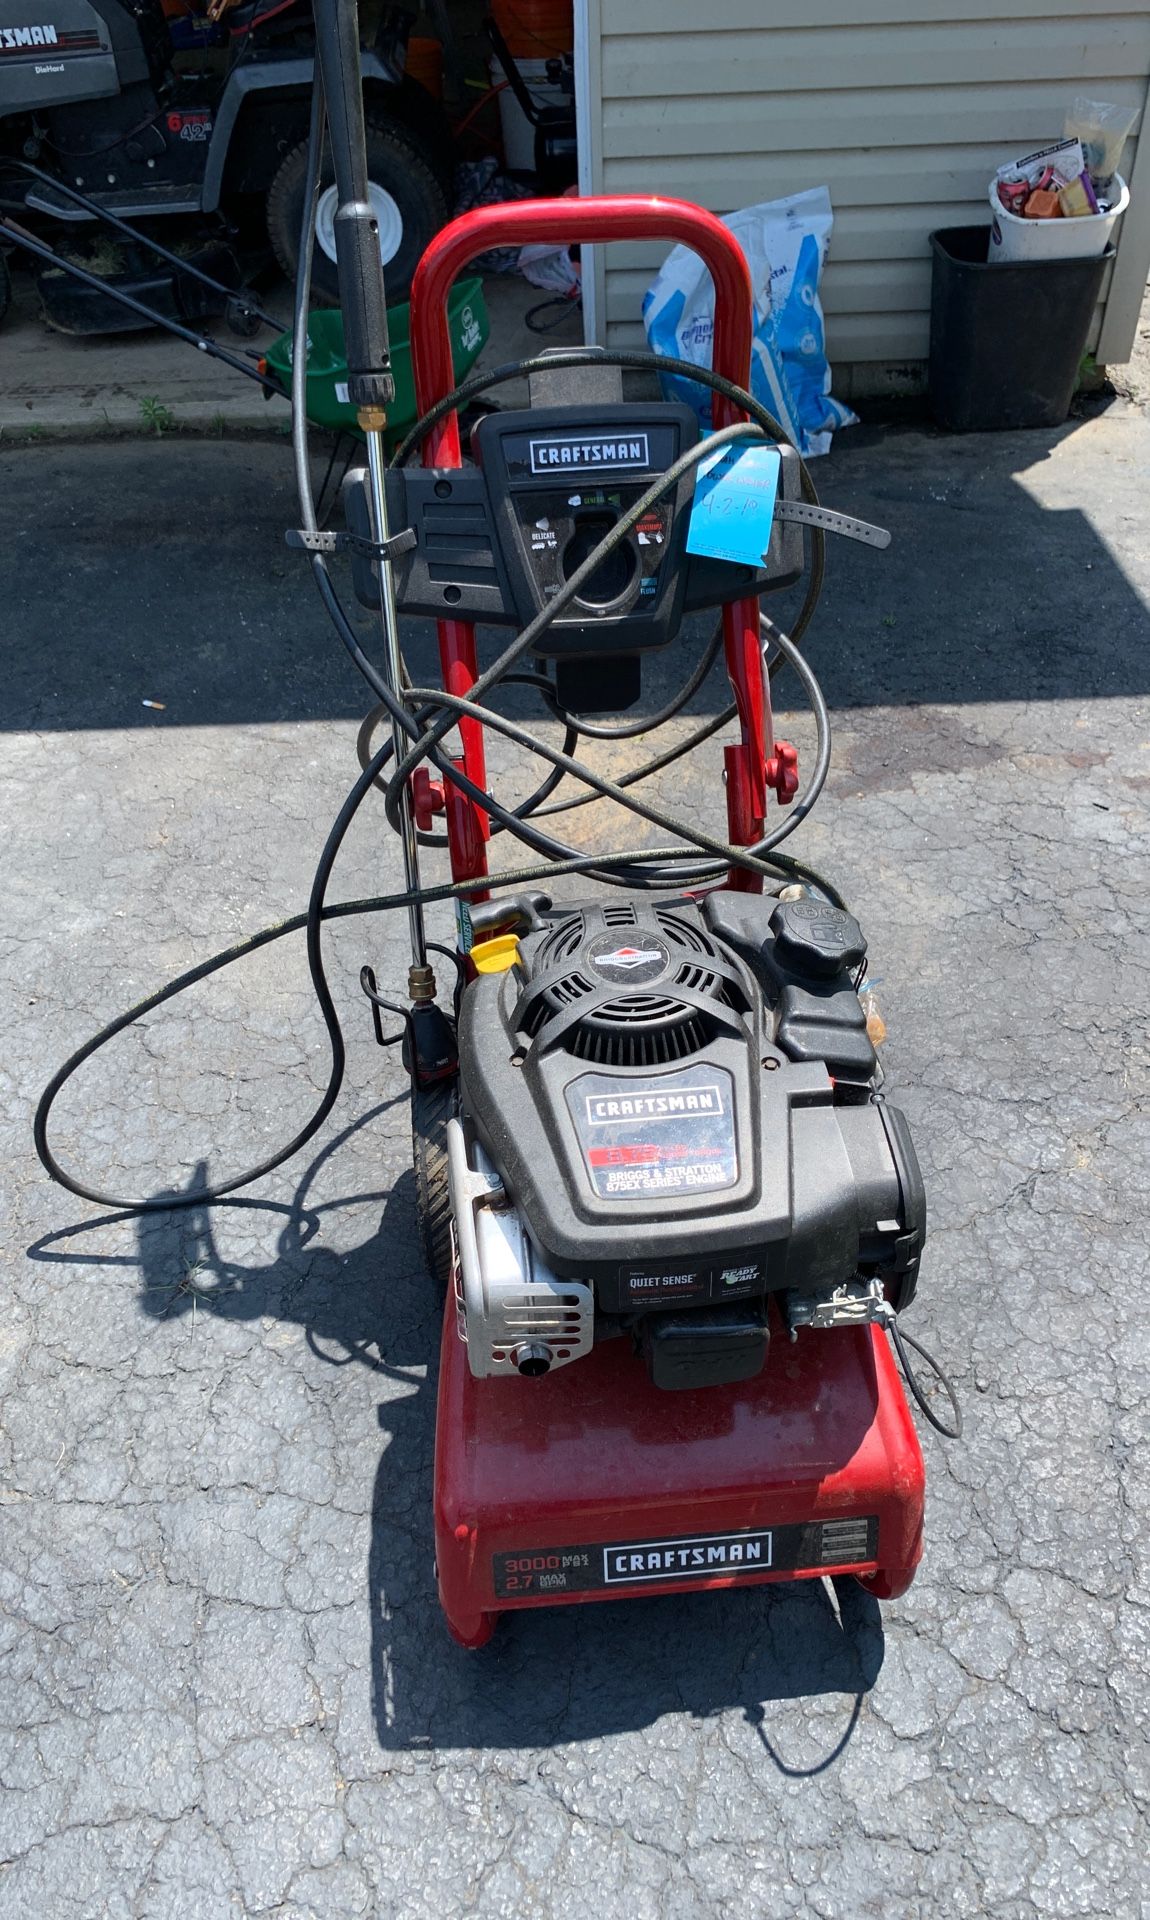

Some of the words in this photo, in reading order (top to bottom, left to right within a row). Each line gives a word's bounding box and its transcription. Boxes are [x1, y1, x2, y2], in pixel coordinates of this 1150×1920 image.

[0, 25, 58, 48] SMAN
[35, 64, 65, 74] DieHard
[167, 113, 181, 133] 6
[538, 443, 641, 464] CRAFTSMAN
[531, 532, 556, 540] DELICATE
[595, 1093, 713, 1117] CRAFTSMAN
[606, 1179, 641, 1192] 875EX
[643, 1176, 682, 1189] SERIES
[685, 1172, 727, 1185] ENGINE
[608, 1168, 650, 1183] BRIGGS
[653, 1168, 663, 1179] &
[664, 1163, 722, 1178] STRATTON
[629, 1277, 661, 1289] QUIET
[504, 1557, 560, 1573] 3000
[561, 1554, 589, 1563] MAX
[562, 1559, 590, 1568] PSI
[615, 1542, 761, 1572] CRAFTSMAN
[506, 1575, 533, 1590] 2.7
[539, 1573, 566, 1581] MAX
